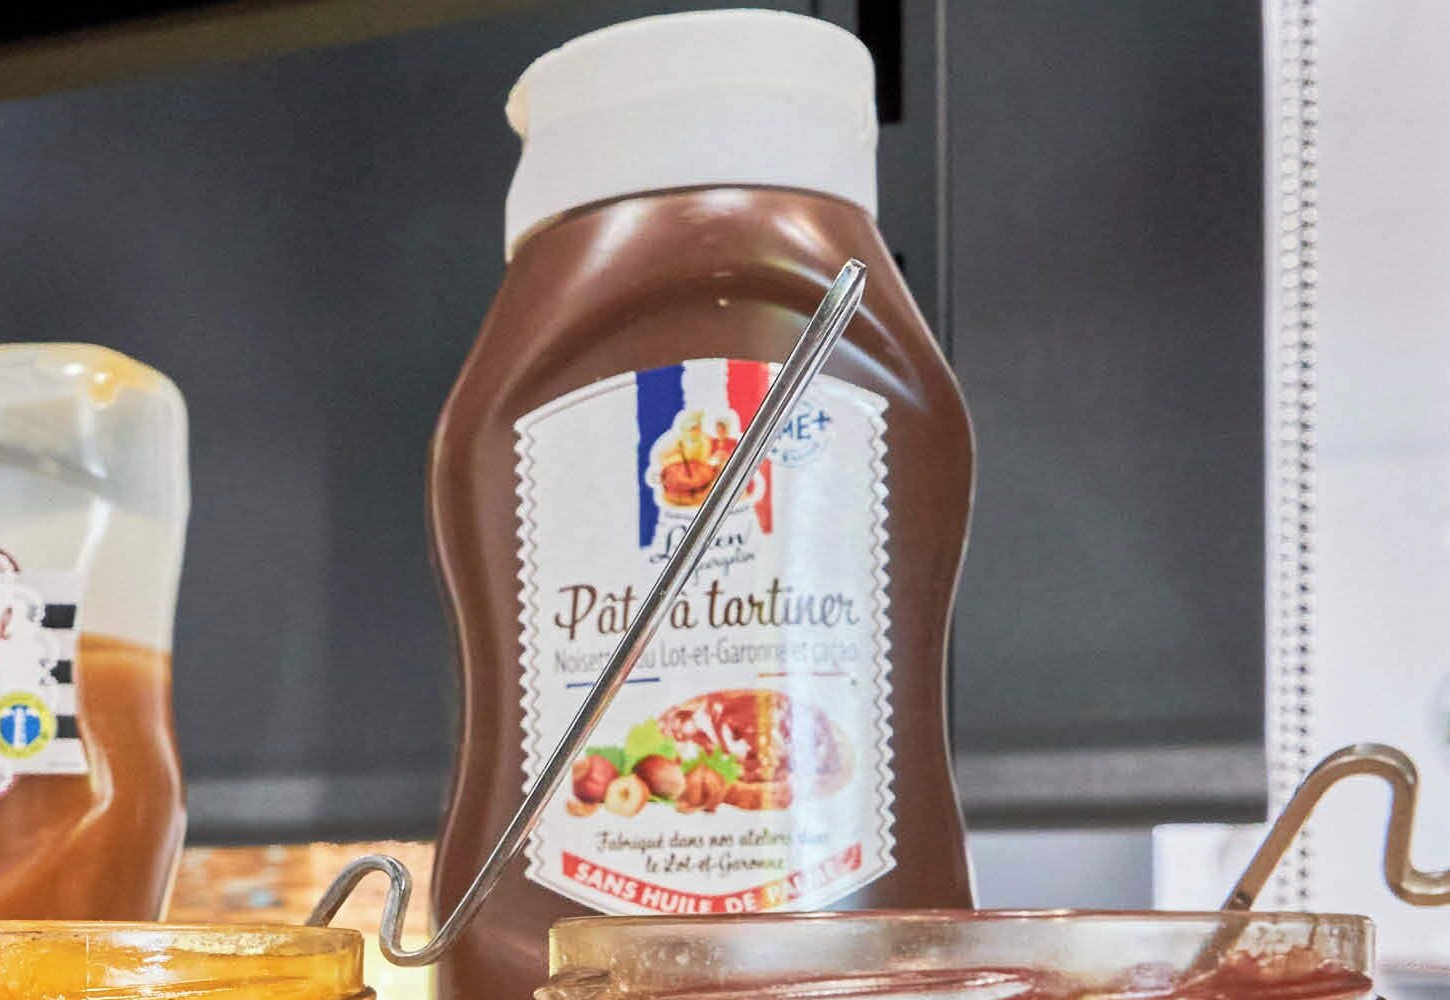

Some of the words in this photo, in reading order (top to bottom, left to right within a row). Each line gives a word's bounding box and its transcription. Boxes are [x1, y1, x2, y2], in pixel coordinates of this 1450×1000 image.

[554, 582, 640, 640] Pât
[670, 590, 699, 629] à
[706, 577, 860, 629] tartiner
[574, 861, 638, 900] SANS
[641, 887, 714, 913] HUILE
[724, 891, 759, 913] DE
